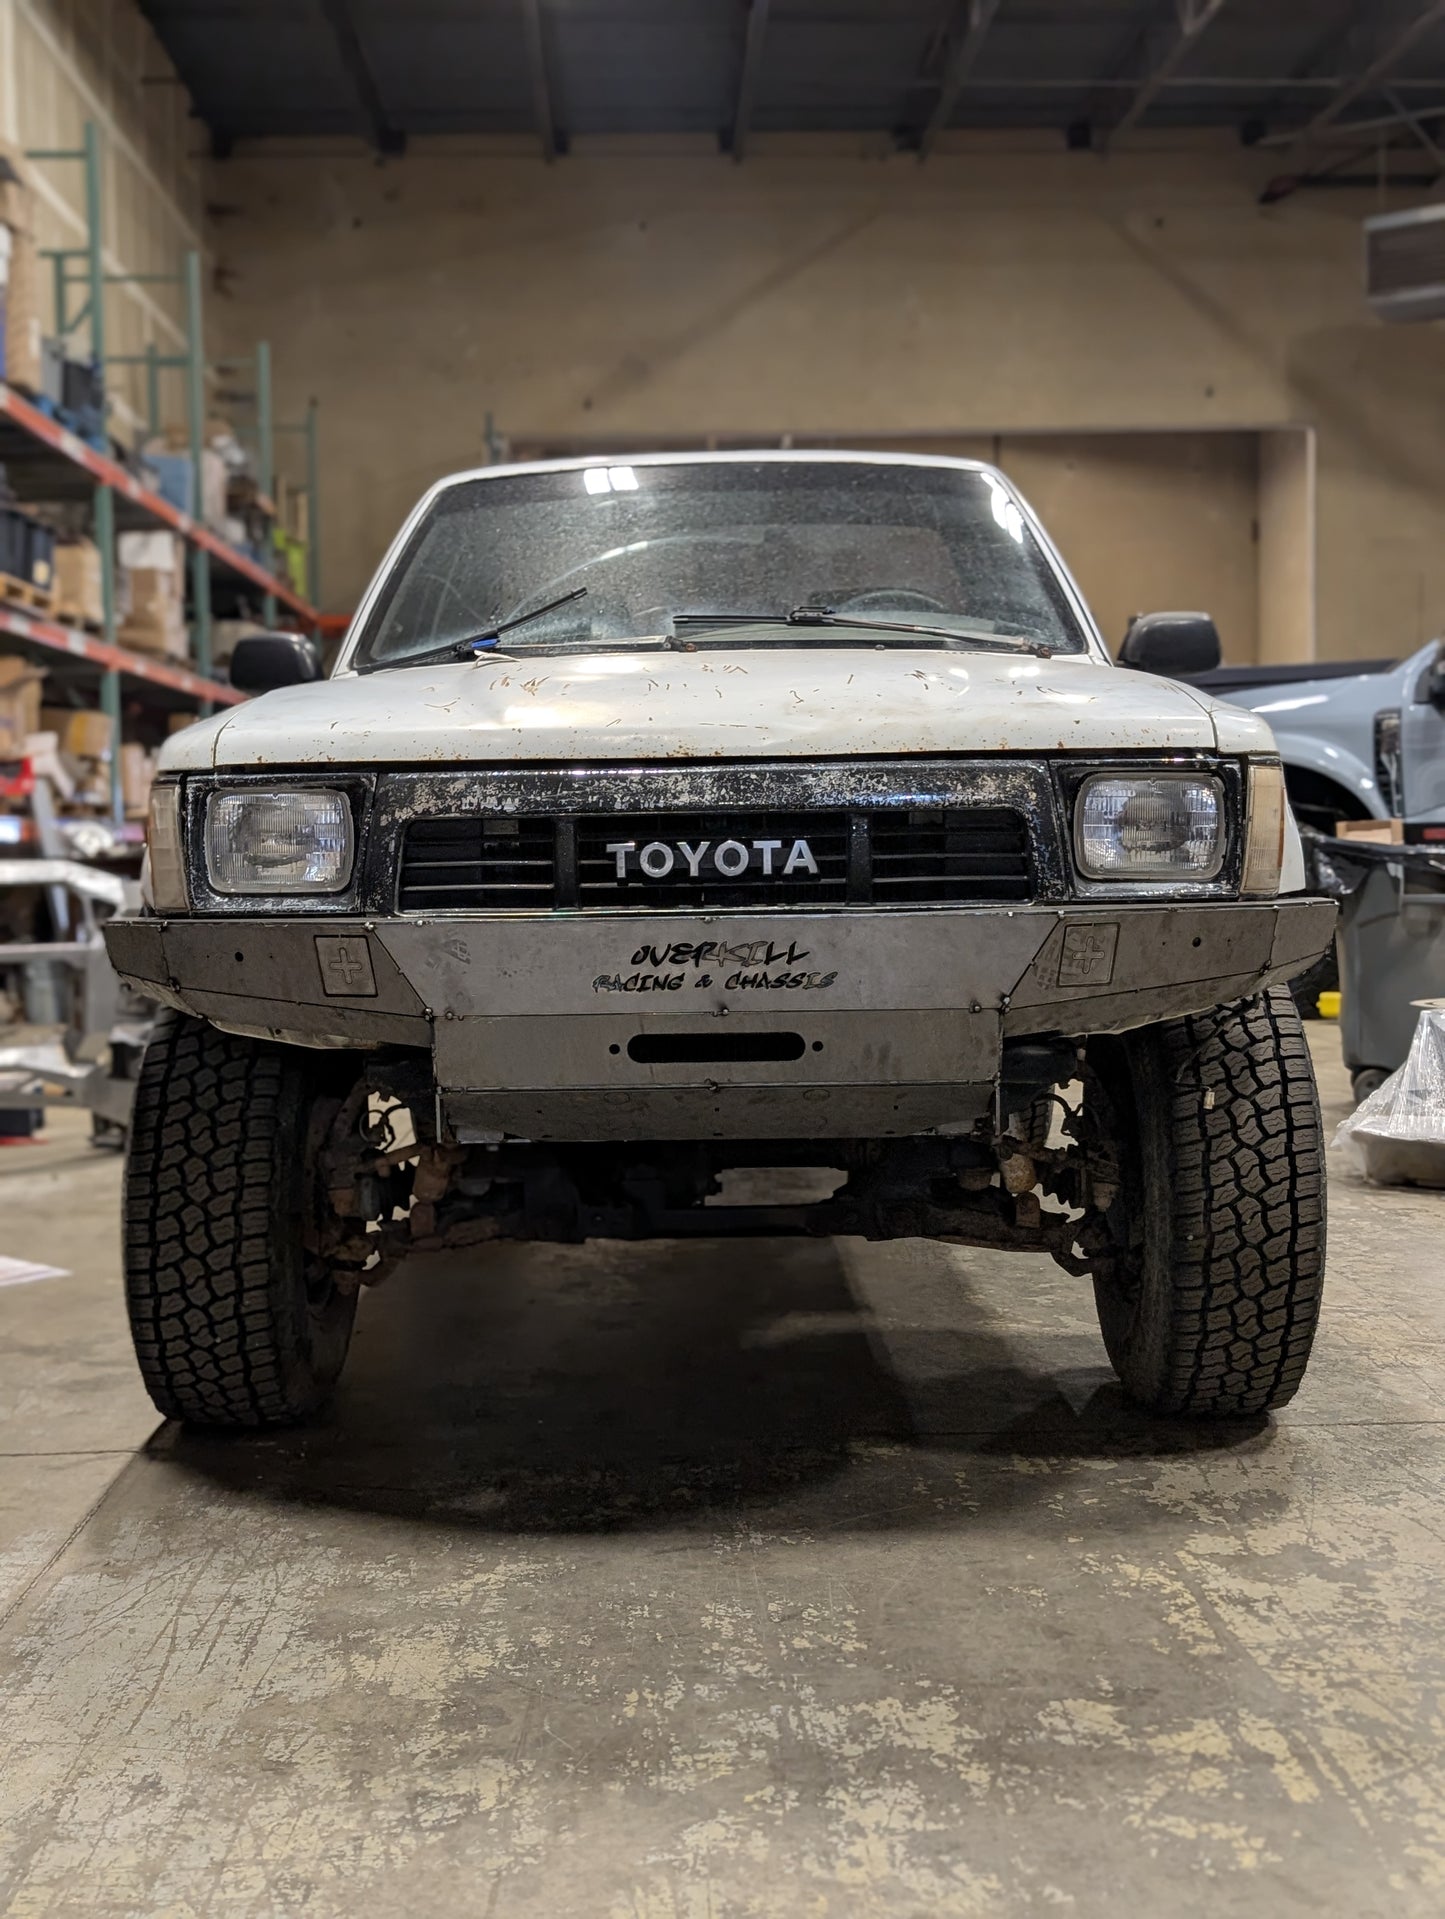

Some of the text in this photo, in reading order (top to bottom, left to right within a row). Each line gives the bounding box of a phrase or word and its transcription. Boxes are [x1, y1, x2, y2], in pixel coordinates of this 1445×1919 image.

[606, 840, 818, 878] TOYOTA
[630, 941, 810, 967] OVERKILL
[592, 971, 838, 993] RACING & CHASSIS
